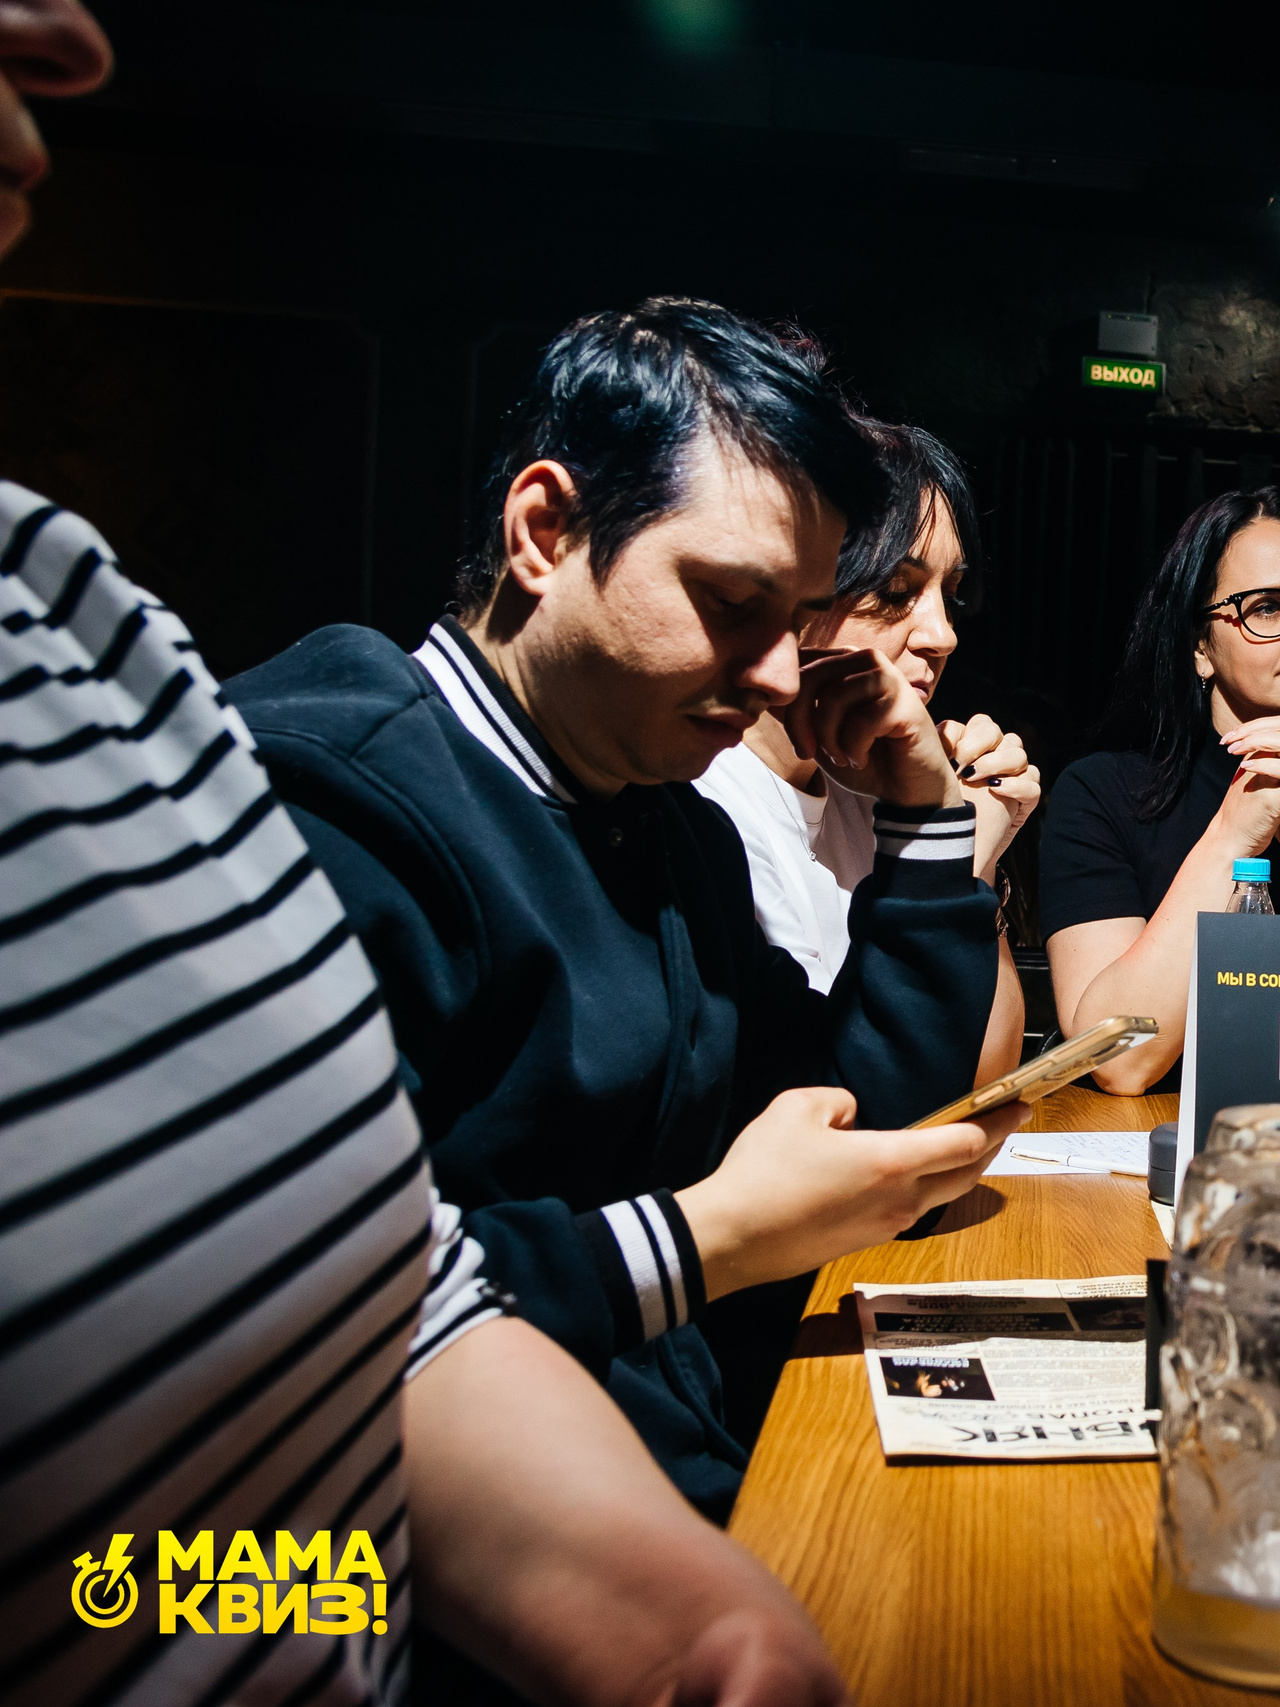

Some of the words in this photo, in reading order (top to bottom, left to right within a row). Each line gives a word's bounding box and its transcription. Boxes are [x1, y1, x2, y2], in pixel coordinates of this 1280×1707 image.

[1090, 364, 1156, 388] ВЫХОД
[1217, 971, 1243, 986] МЫ
[1246, 973, 1256, 987] В
[1025, 1407, 1134, 1419] РОПАБ
[950, 1421, 1134, 1443] БНЯК
